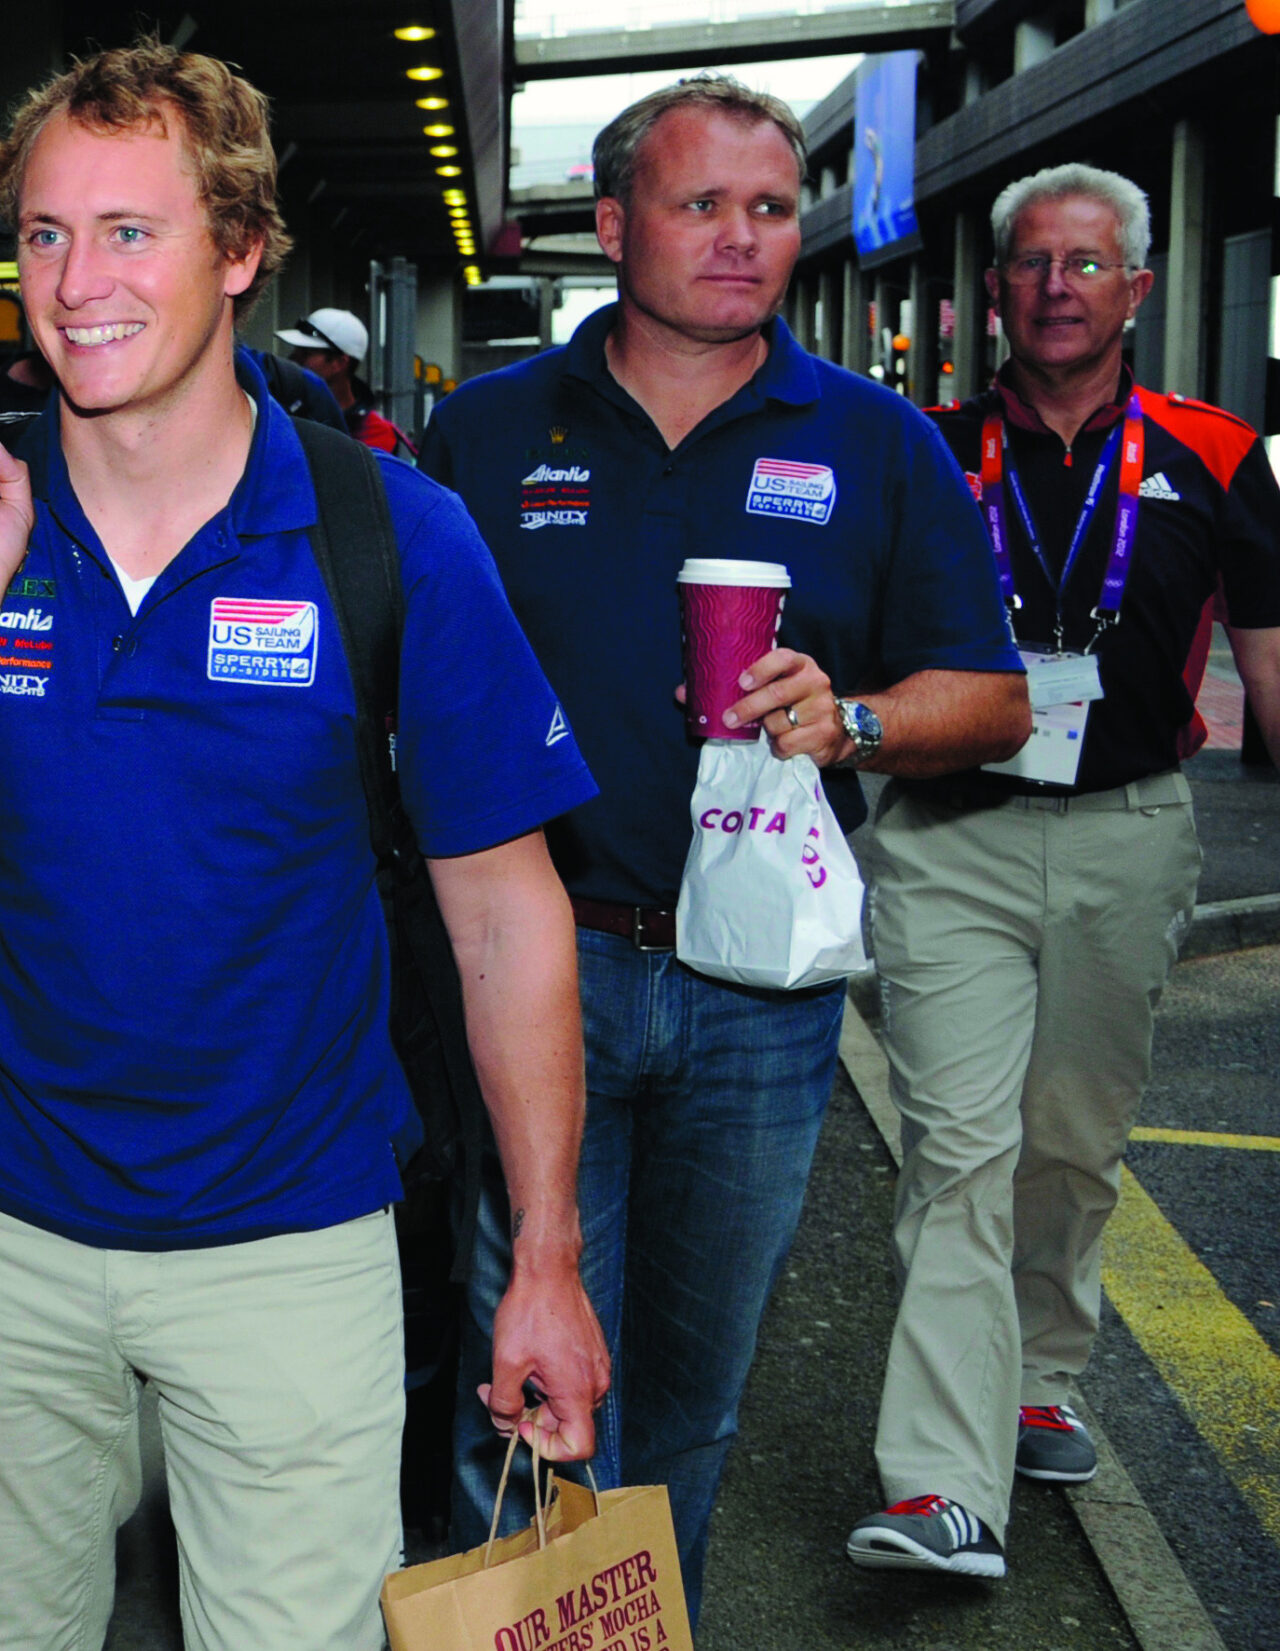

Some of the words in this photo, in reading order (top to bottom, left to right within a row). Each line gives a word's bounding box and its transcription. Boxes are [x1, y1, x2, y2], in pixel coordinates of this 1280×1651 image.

[754, 476, 787, 491] US
[788, 486, 824, 498] TEAM
[753, 494, 813, 508] SPERRY
[521, 509, 588, 522] TRINITY
[212, 624, 252, 646] US
[254, 626, 301, 638] SAILING
[254, 637, 300, 649] TEAM
[214, 653, 290, 669] SPERRY
[214, 665, 288, 678] TOP-SIDER
[1, 684, 45, 697] YACHTS
[494, 1608, 550, 1651] OUR
[555, 1550, 657, 1633] MASTER
[599, 1589, 662, 1641] MOCHA
[630, 1626, 651, 1651] IS
[656, 1618, 668, 1644] A
